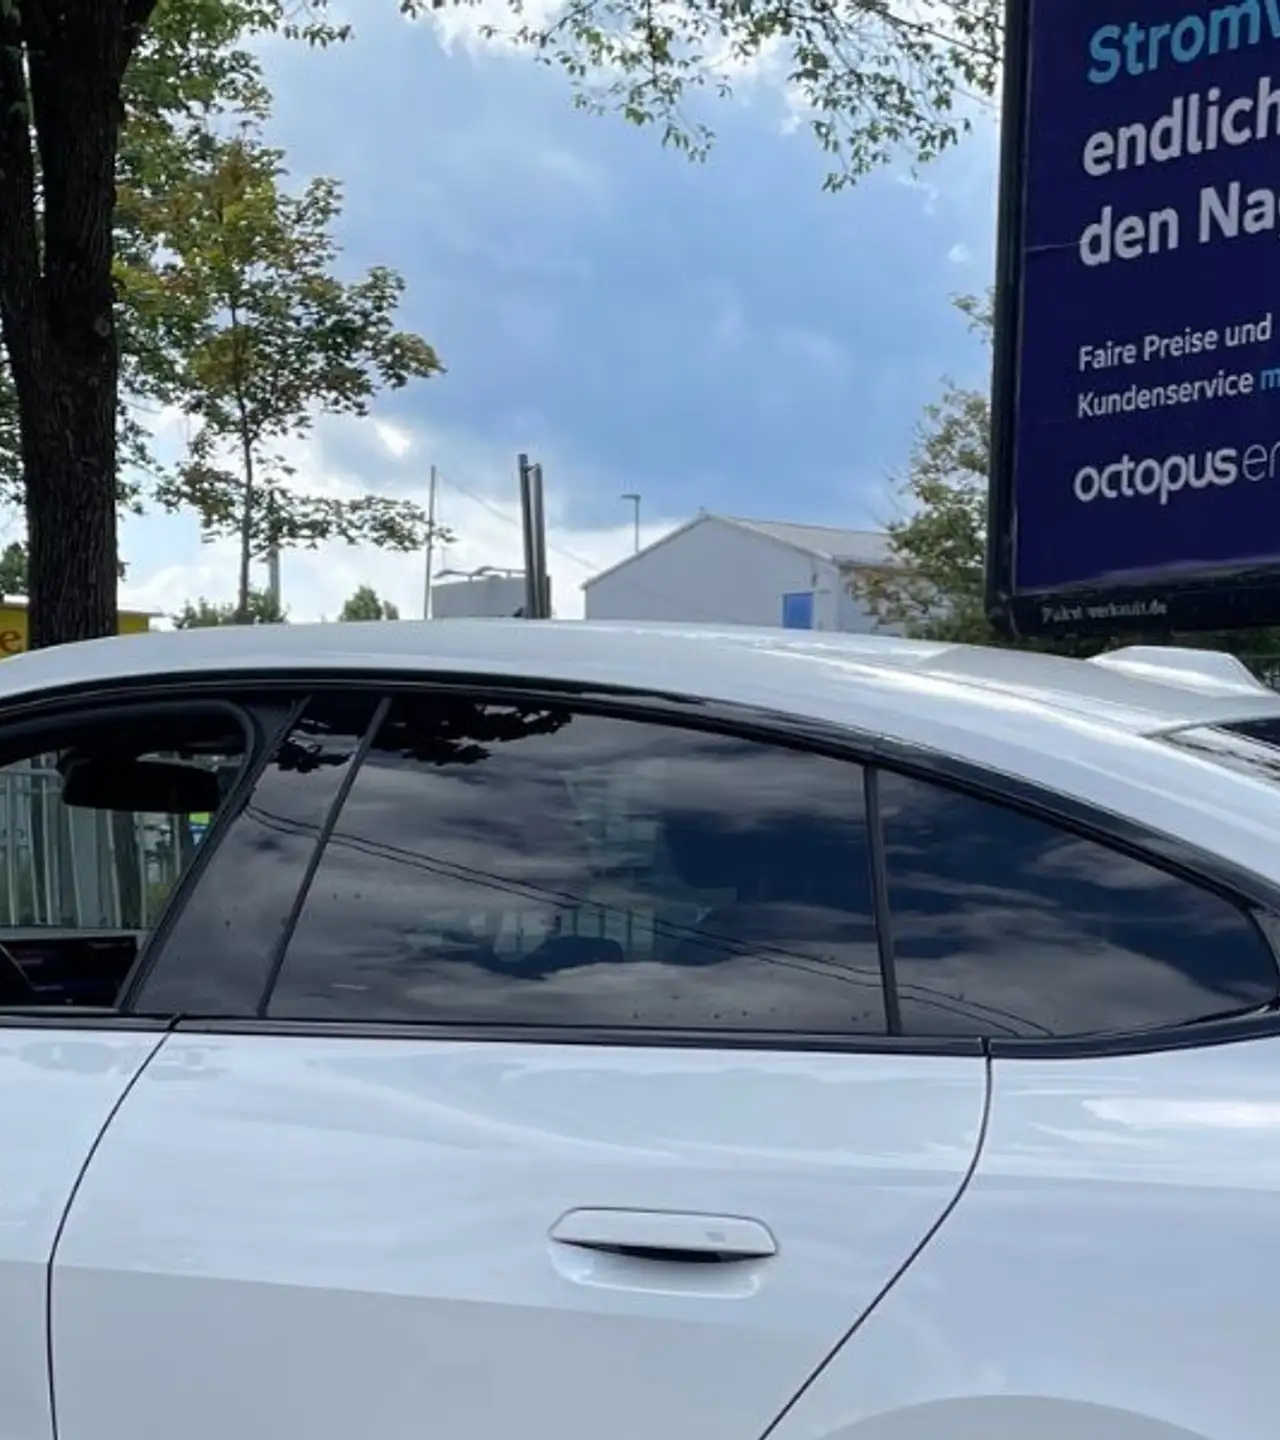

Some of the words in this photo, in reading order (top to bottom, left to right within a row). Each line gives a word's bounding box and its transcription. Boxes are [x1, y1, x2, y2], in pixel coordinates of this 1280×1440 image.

[1079, 206, 1179, 267] den
[1078, 340, 1137, 371] Faire
[1143, 327, 1219, 361] Preise
[1224, 312, 1272, 347] und
[1077, 370, 1254, 418] Kundenservice
